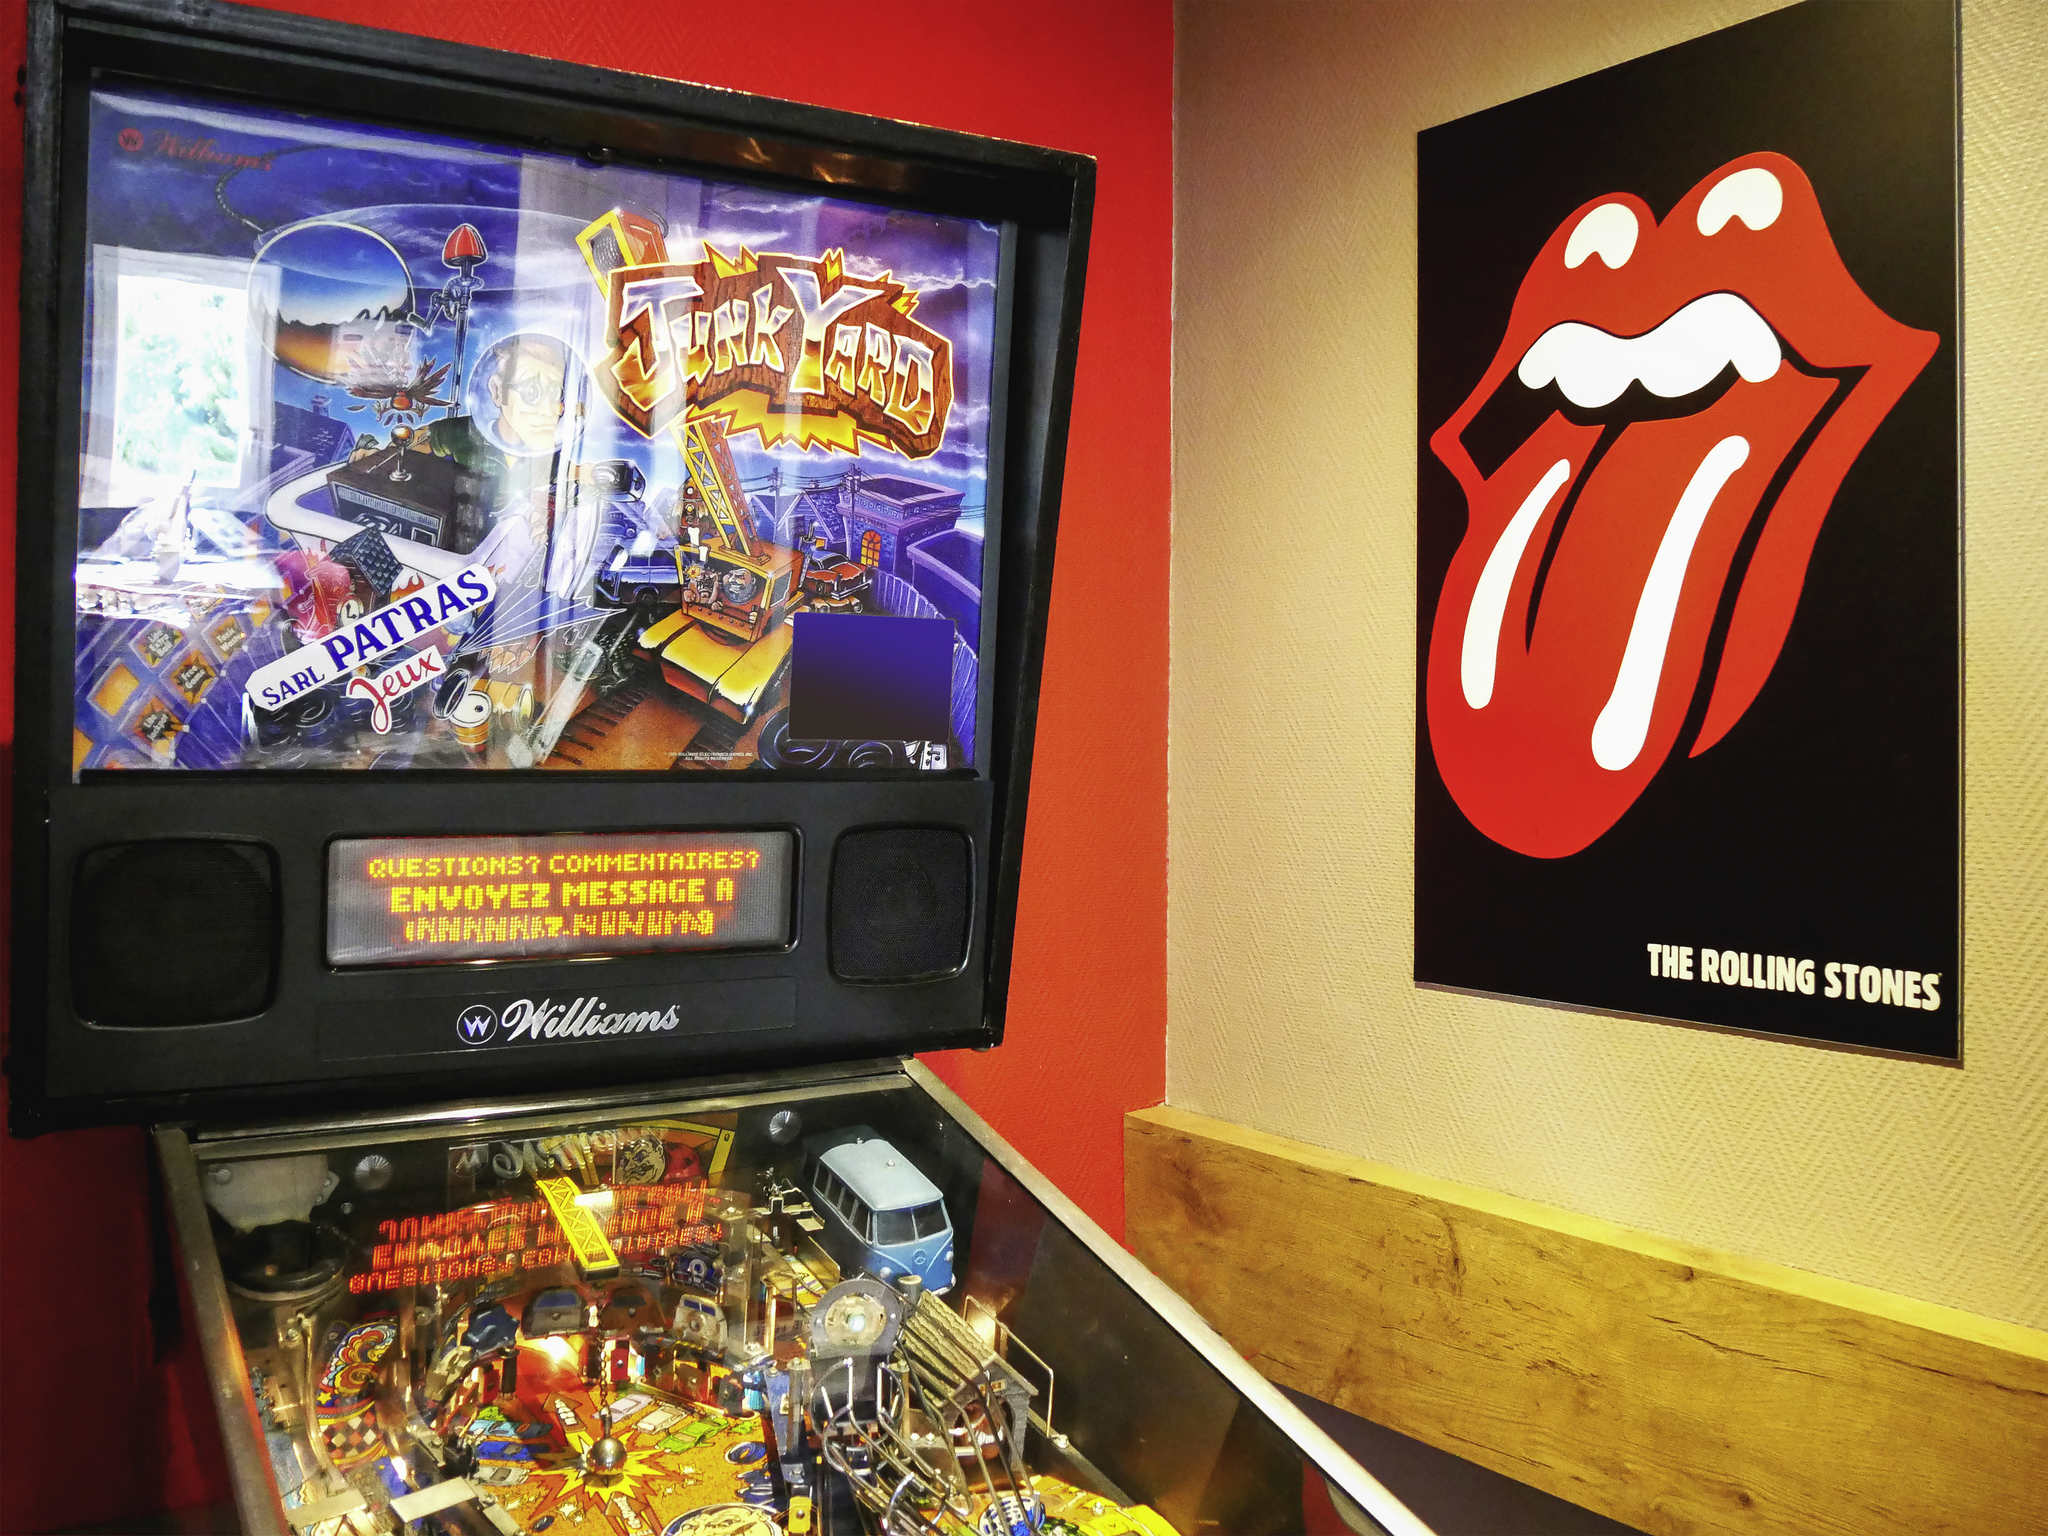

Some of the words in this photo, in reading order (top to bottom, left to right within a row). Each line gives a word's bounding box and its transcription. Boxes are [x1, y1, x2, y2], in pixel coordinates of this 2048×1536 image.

[262, 666, 325, 707] SARL
[321, 570, 489, 673] PATRAS
[349, 652, 441, 733] Jeux
[369, 855, 541, 878] QUESTIONS?
[549, 851, 760, 874] COMMENTAIRES?
[391, 882, 550, 912] ENVOYEZ
[562, 878, 706, 907] MESSAGE
[716, 877, 734, 902] A
[1647, 943, 1694, 980] THE
[1701, 948, 1816, 996] ROLLING
[1824, 962, 1942, 1012] STONES
[501, 997, 680, 1041] Williams
